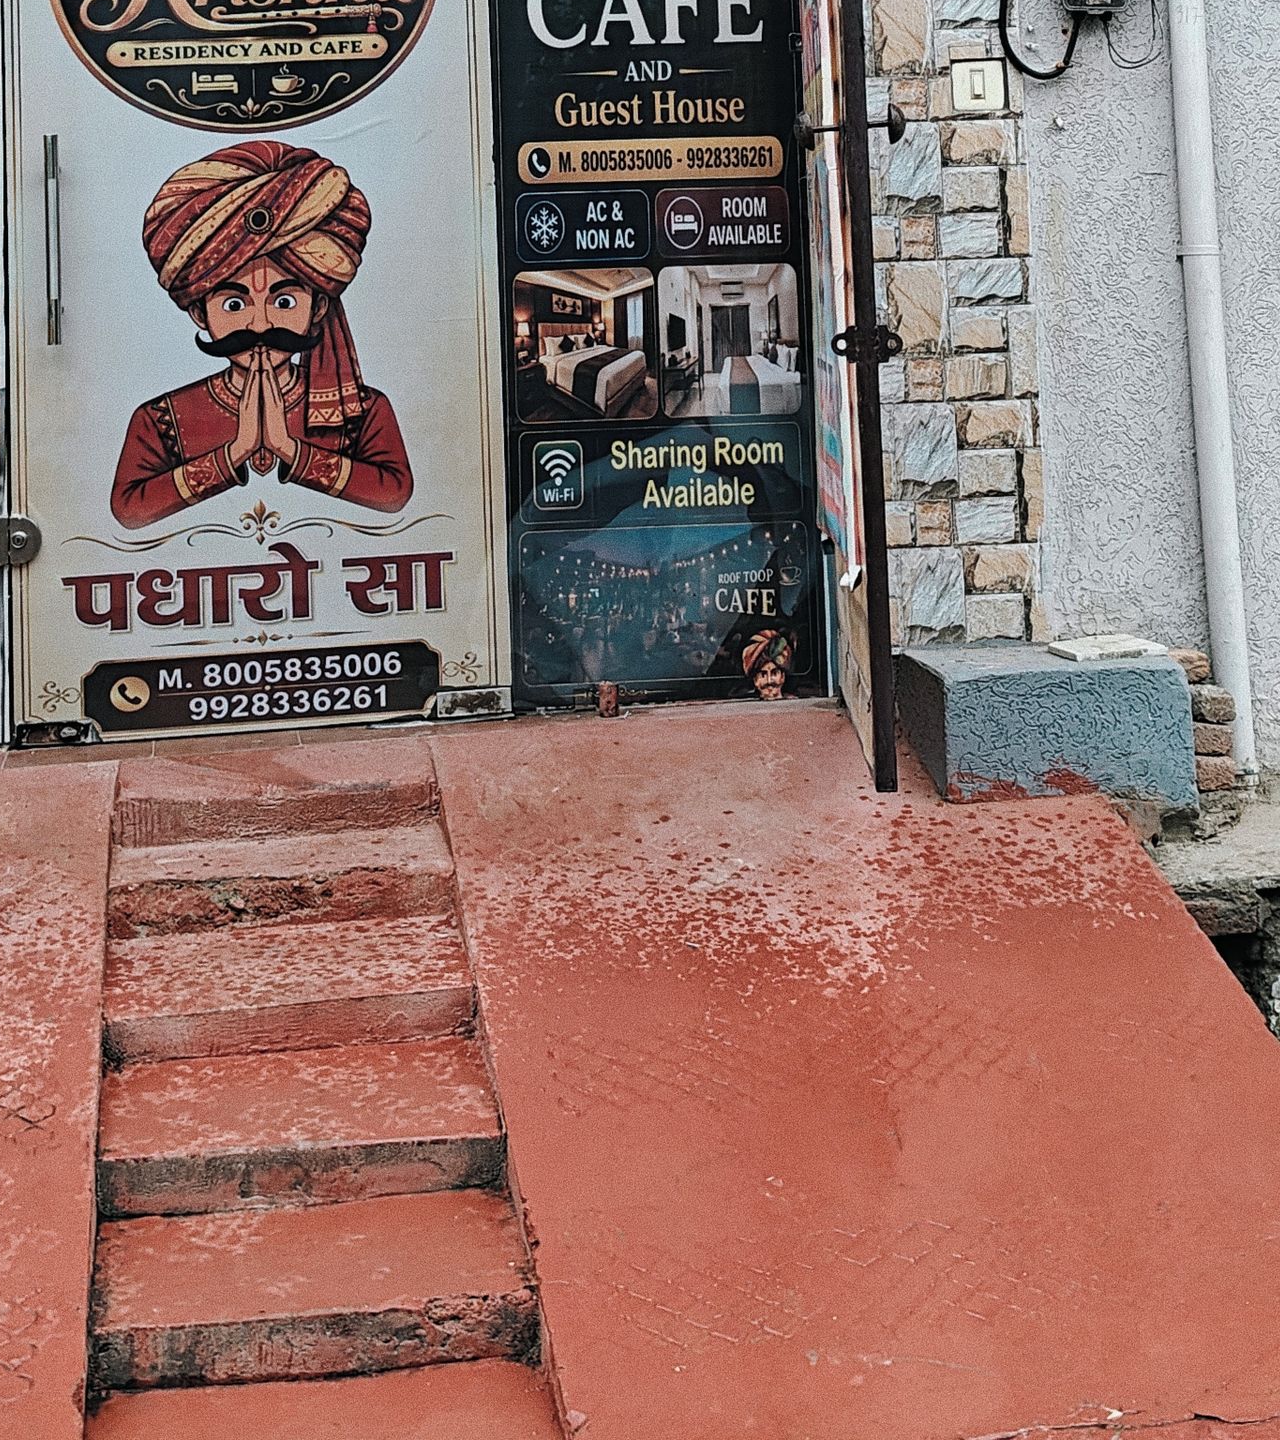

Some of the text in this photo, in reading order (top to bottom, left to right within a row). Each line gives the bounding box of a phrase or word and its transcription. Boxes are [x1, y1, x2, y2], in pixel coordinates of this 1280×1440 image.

[133, 39, 364, 61] RESIDENCY AND CAFE
[624, 60, 672, 83] AND
[554, 89, 745, 128] Guest House
[558, 151, 577, 173] M.
[581, 148, 673, 172] 8005835006
[686, 145, 774, 169] 9928336261
[586, 200, 624, 222] AC &
[721, 196, 767, 218] ROOM
[576, 228, 635, 250] NON AC
[708, 223, 783, 246] AVAILABLE
[610, 437, 785, 474] Sharing Room
[542, 487, 575, 504] Wi-Fi
[643, 476, 756, 509] Available
[61, 541, 454, 632] पधारो सा
[717, 568, 774, 584] ROOF TOOP
[714, 588, 777, 617] CAFE
[158, 650, 403, 691] M. 8005835006
[188, 684, 387, 720] 9928336261
